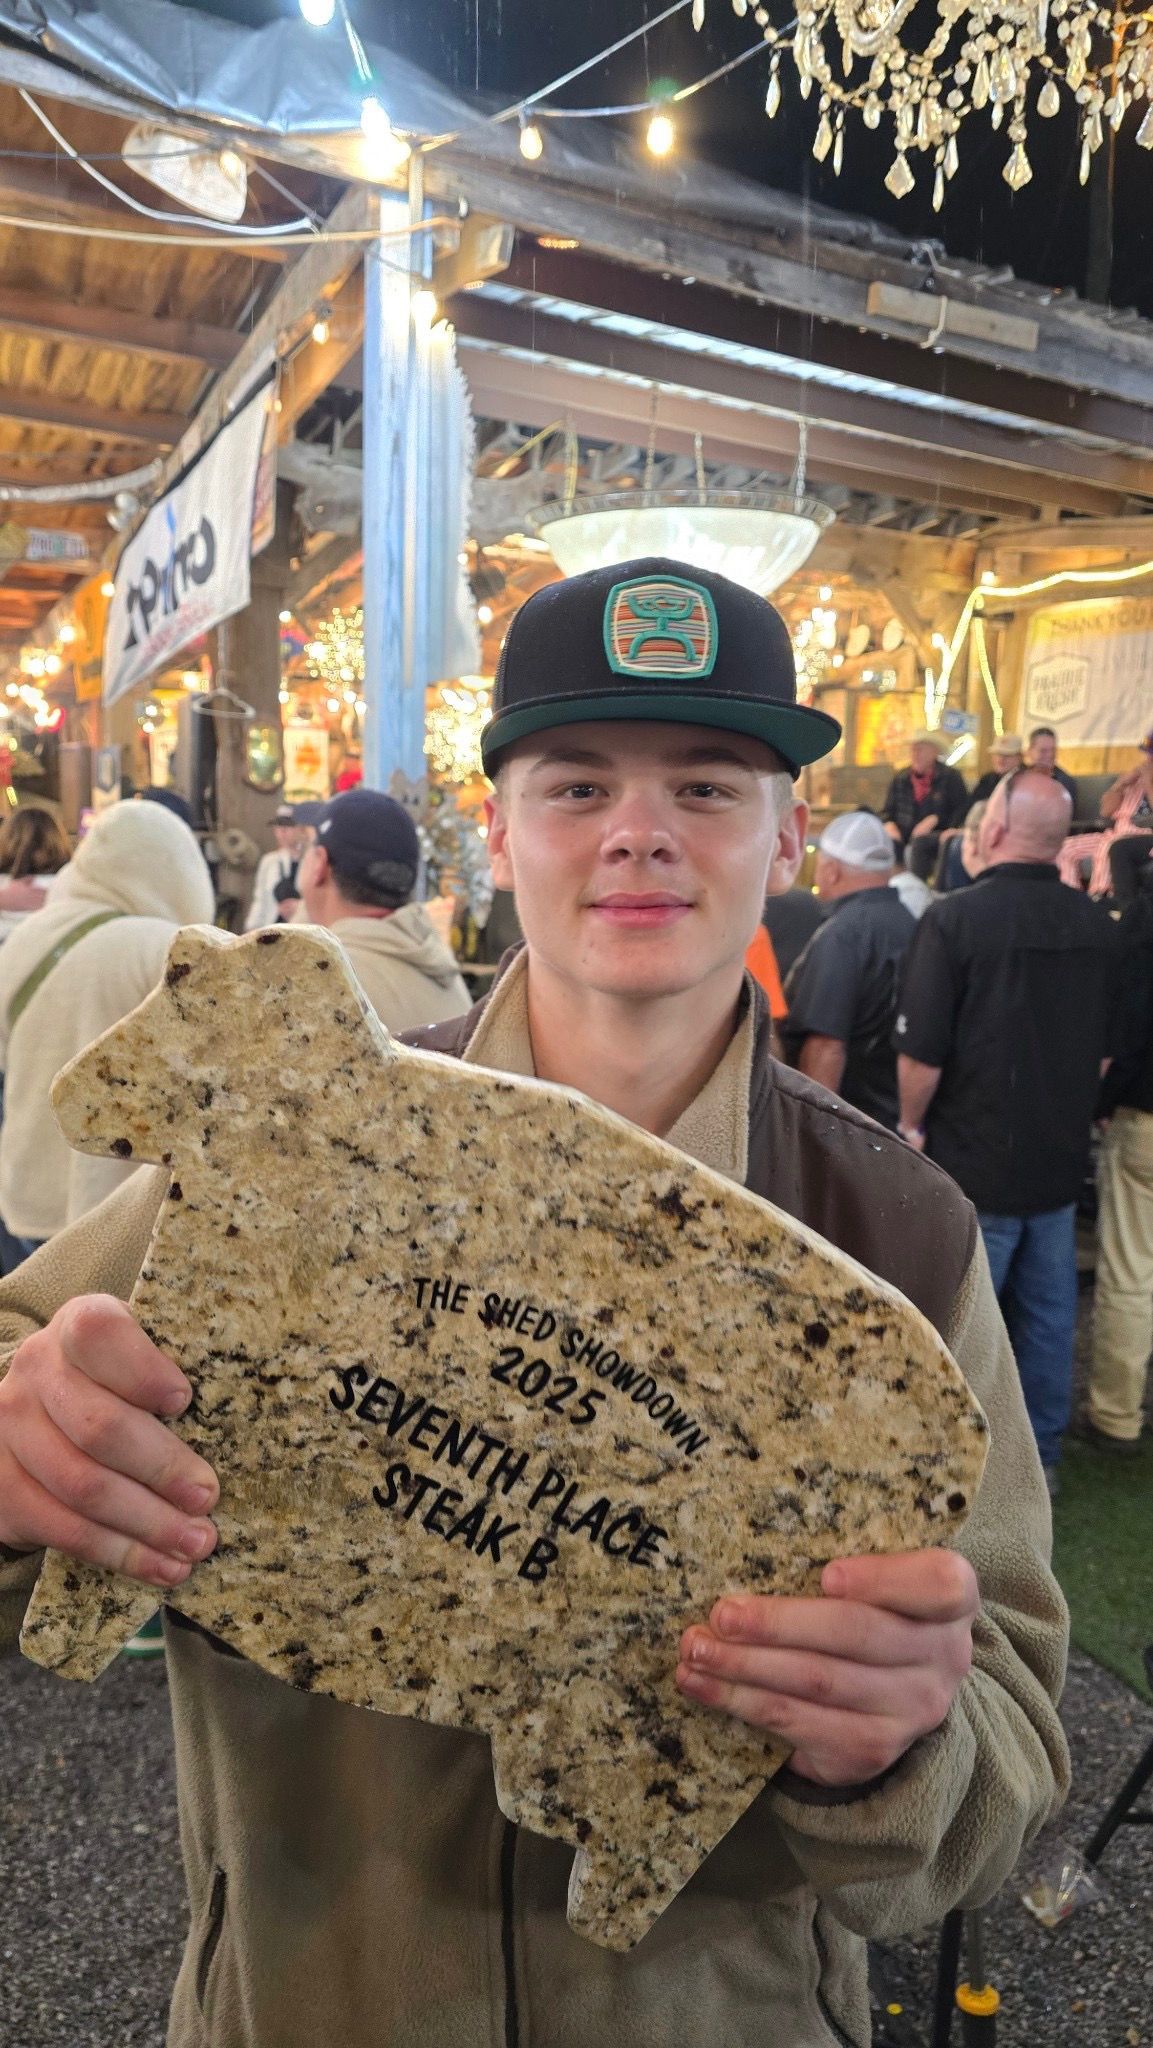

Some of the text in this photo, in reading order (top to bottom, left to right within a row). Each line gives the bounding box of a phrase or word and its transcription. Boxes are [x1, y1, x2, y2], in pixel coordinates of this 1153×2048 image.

[413, 1276, 710, 1456] THE SHED SHOWDOWN
[490, 1346, 606, 1425] 2025
[328, 1365, 669, 1566] SEVENTH PLACE
[373, 1463, 559, 1581] STEAK B
